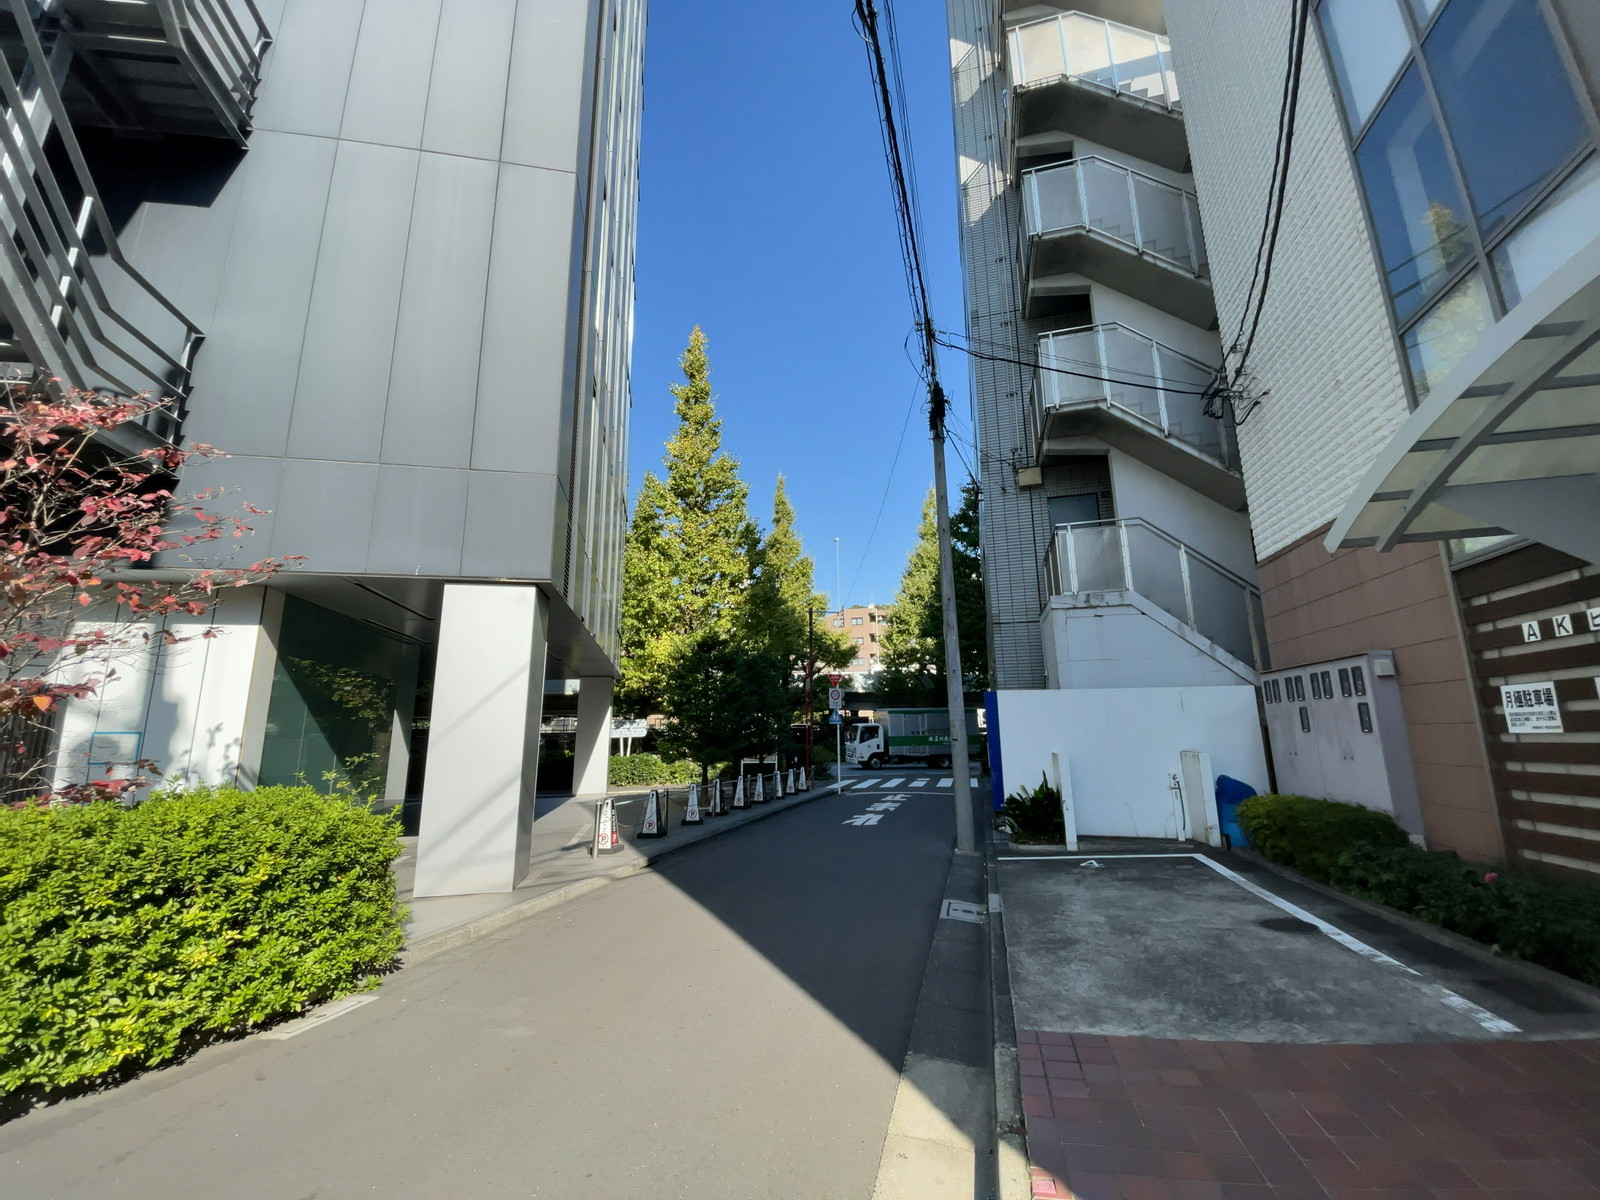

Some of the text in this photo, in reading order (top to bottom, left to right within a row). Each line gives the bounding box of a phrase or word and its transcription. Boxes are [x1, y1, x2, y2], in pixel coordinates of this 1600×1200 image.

[1504, 688, 1555, 708] 月極駐車場
[841, 794, 911, 825] 止まれ
